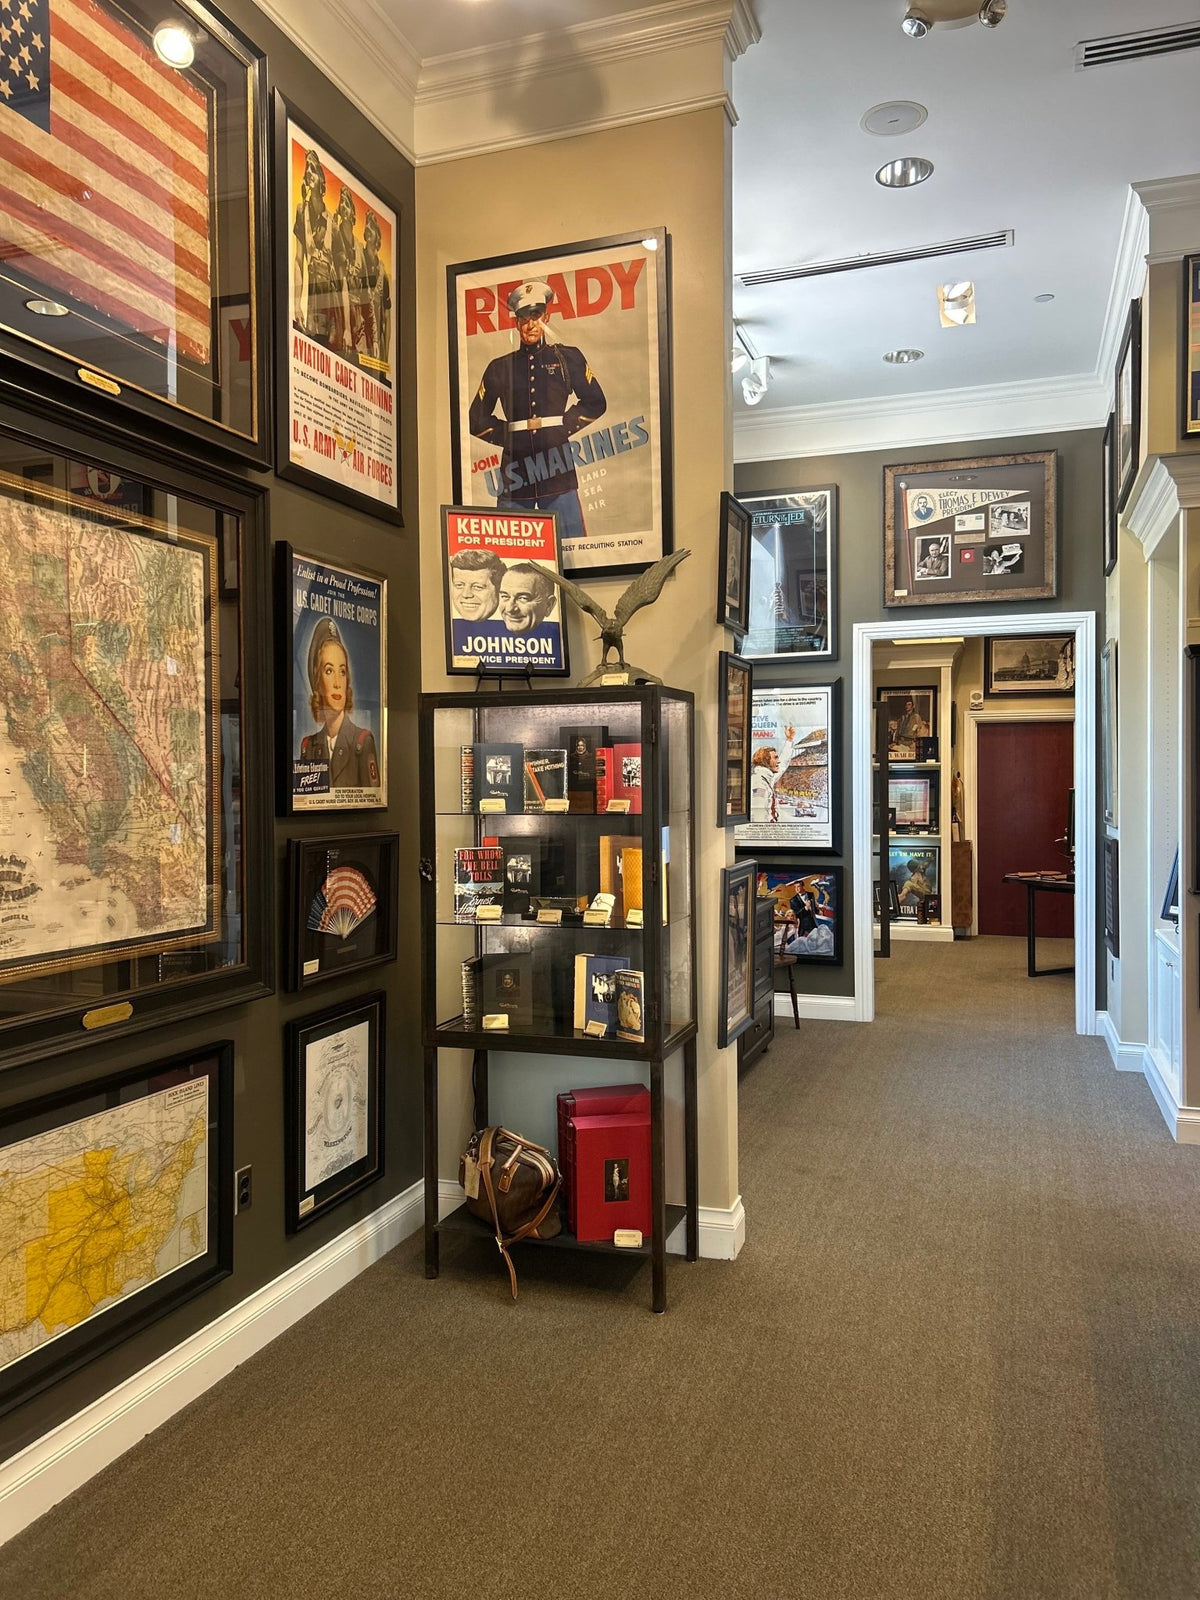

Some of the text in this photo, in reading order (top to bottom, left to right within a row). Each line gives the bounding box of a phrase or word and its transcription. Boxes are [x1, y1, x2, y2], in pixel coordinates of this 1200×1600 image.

[464, 257, 647, 336] READY
[293, 336, 331, 378] AVIATION
[335, 361, 357, 393] CADET
[361, 376, 393, 415] TRAINING
[300, 370, 319, 384] BECOME
[314, 430, 337, 461] ARMY
[352, 448, 364, 474] AIR
[368, 456, 393, 488] FORCES
[471, 454, 499, 474] JOIN
[580, 468, 607, 483] LAND
[584, 484, 603, 497] SEA
[588, 499, 606, 512] AIR
[938, 494, 969, 509] THOMAS
[980, 491, 1010, 502] DEWEY
[942, 503, 976, 517] PRESIDENT
[752, 514, 780, 524] ETURN
[786, 511, 804, 526] JEDI
[456, 518, 544, 538] KENNEDY
[457, 536, 545, 547] FOR PRESIDENT
[578, 542, 615, 550] RECRUITING
[618, 539, 643, 547] STATION
[296, 564, 316, 581] Enlist
[316, 573, 324, 582] in
[329, 575, 347, 590] Proud
[347, 580, 378, 598] Profession!
[296, 589, 377, 626] U.S. CADET NURSE CORPS
[462, 636, 552, 654] JOHNSON
[300, 772, 320, 787] FREE!
[460, 850, 502, 860] FOR WHOM
[462, 861, 498, 871] THE BELL
[470, 872, 492, 881] TOLLS
[470, 895, 495, 905] Ernest
[900, 905, 915, 914] XTRA
